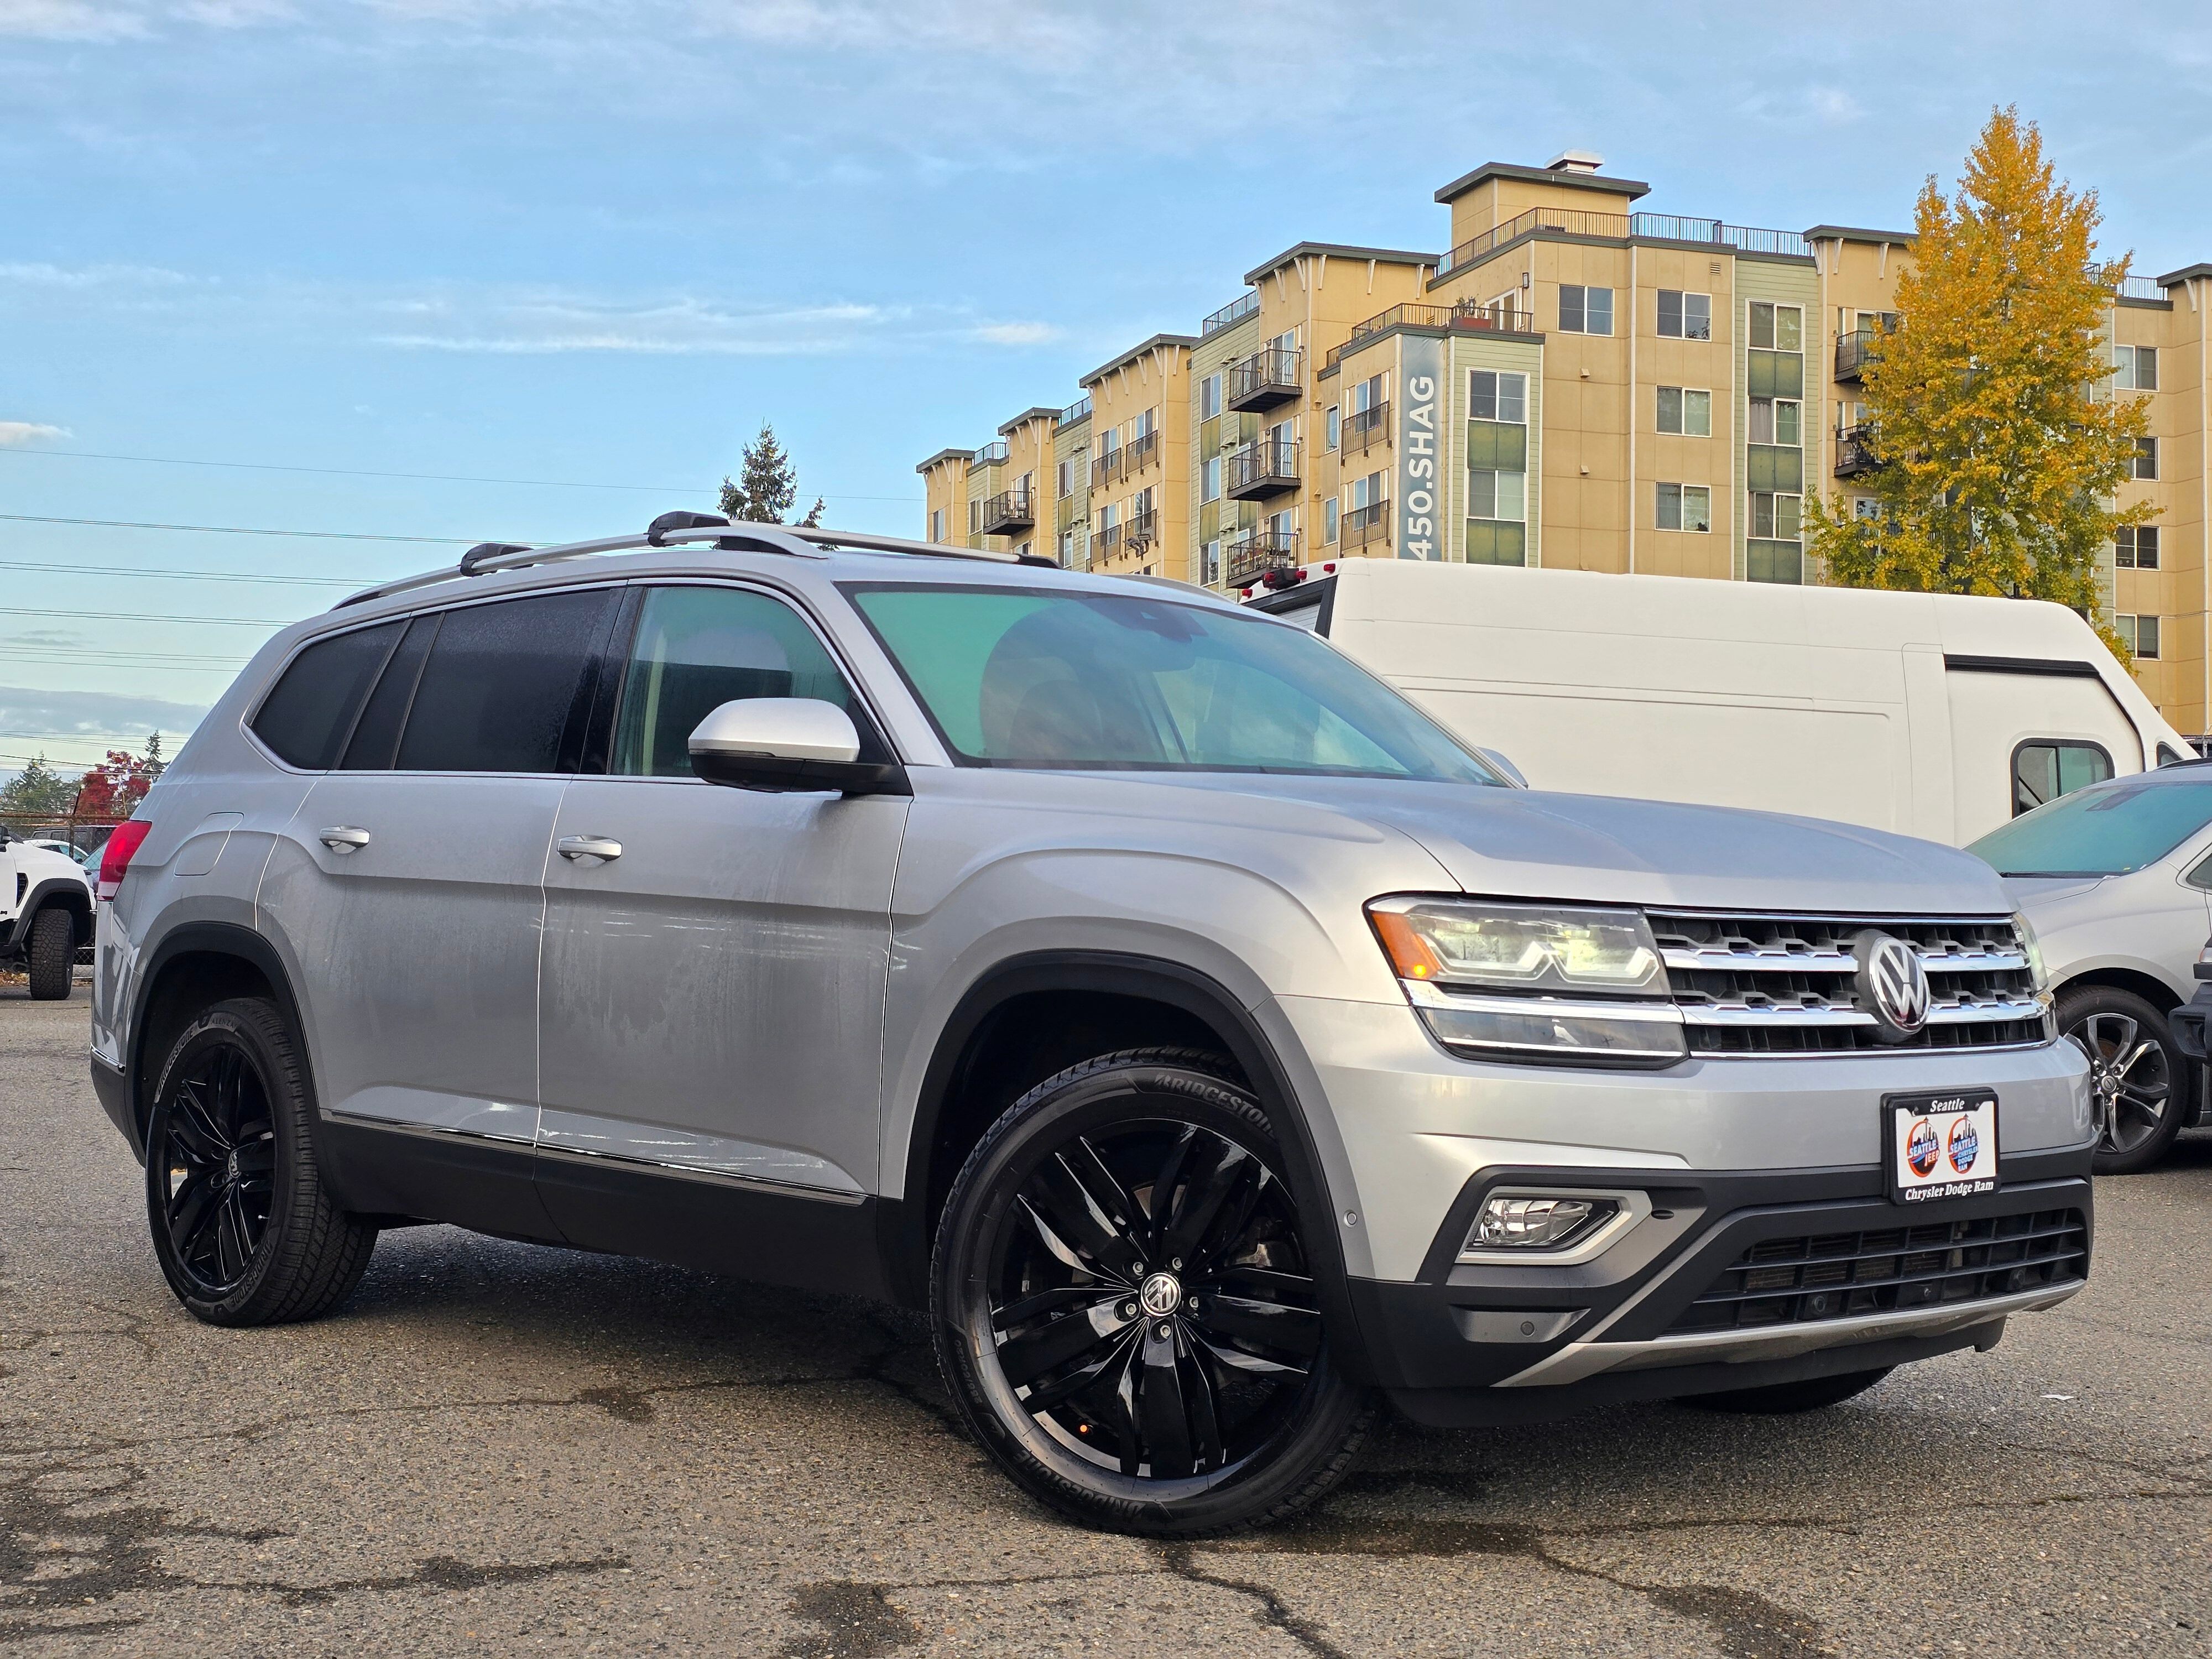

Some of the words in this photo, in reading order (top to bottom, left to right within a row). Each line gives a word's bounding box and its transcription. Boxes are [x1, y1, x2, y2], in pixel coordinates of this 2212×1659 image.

[1407, 377, 1434, 561] 450.SHAG
[211, 1017, 234, 1029] ALENZA
[1154, 1074, 1276, 1138] BRIDGESTON
[1930, 1098, 1965, 1113] Seattle
[1908, 1140, 1937, 1158] SEATTLE
[1949, 1137, 1976, 1155] SEATTLE
[1958, 1146, 1978, 1157] CHRYSLER
[1924, 1150, 1939, 1166] JEEP
[1958, 1154, 1973, 1165] DODGE
[1906, 1186, 1944, 1201] Chrysler
[1945, 1183, 1973, 1196] Dodge
[1974, 1181, 1994, 1192] Ram
